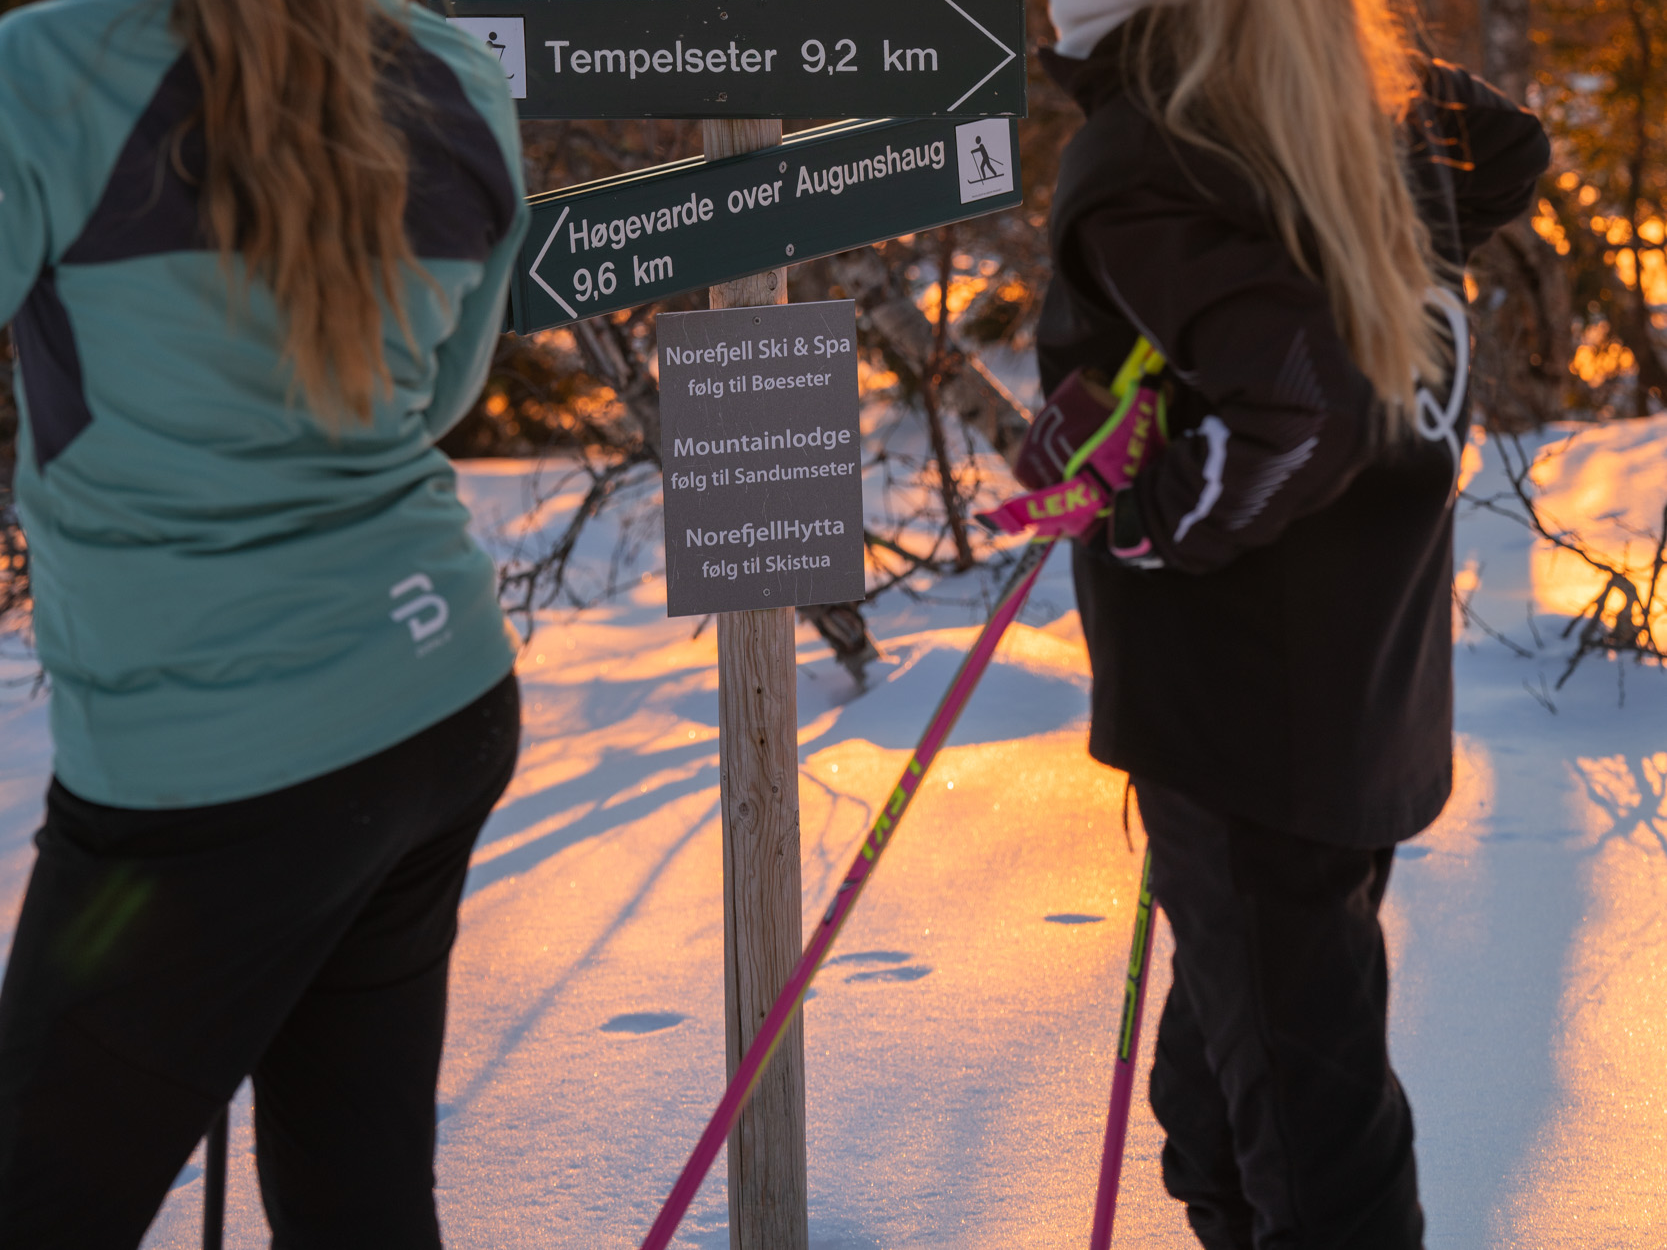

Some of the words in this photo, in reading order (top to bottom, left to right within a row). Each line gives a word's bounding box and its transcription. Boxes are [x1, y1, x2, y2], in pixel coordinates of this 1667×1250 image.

[544, 40, 778, 80] Tempelseter
[800, 38, 858, 76] 9,2
[883, 39, 938, 72] km
[568, 192, 714, 253] Høgevarde
[727, 180, 783, 214] over
[795, 138, 946, 198] Augunshaug
[572, 261, 617, 302] 9,6
[632, 254, 674, 287] km
[666, 340, 753, 367] Norefjell
[758, 338, 788, 359] Ski
[793, 336, 809, 356] &
[813, 335, 851, 359] Spa
[687, 377, 724, 399] følg
[728, 375, 747, 393] til
[752, 372, 832, 391] Bøeseter
[673, 427, 851, 457] Mountainlodge
[670, 471, 707, 492] følg
[711, 468, 730, 486] til
[734, 461, 855, 485] Sandumseter
[686, 518, 845, 548] NorefjellHytta
[701, 559, 738, 580] følg
[742, 556, 761, 575] til
[765, 554, 831, 573] Skistua
